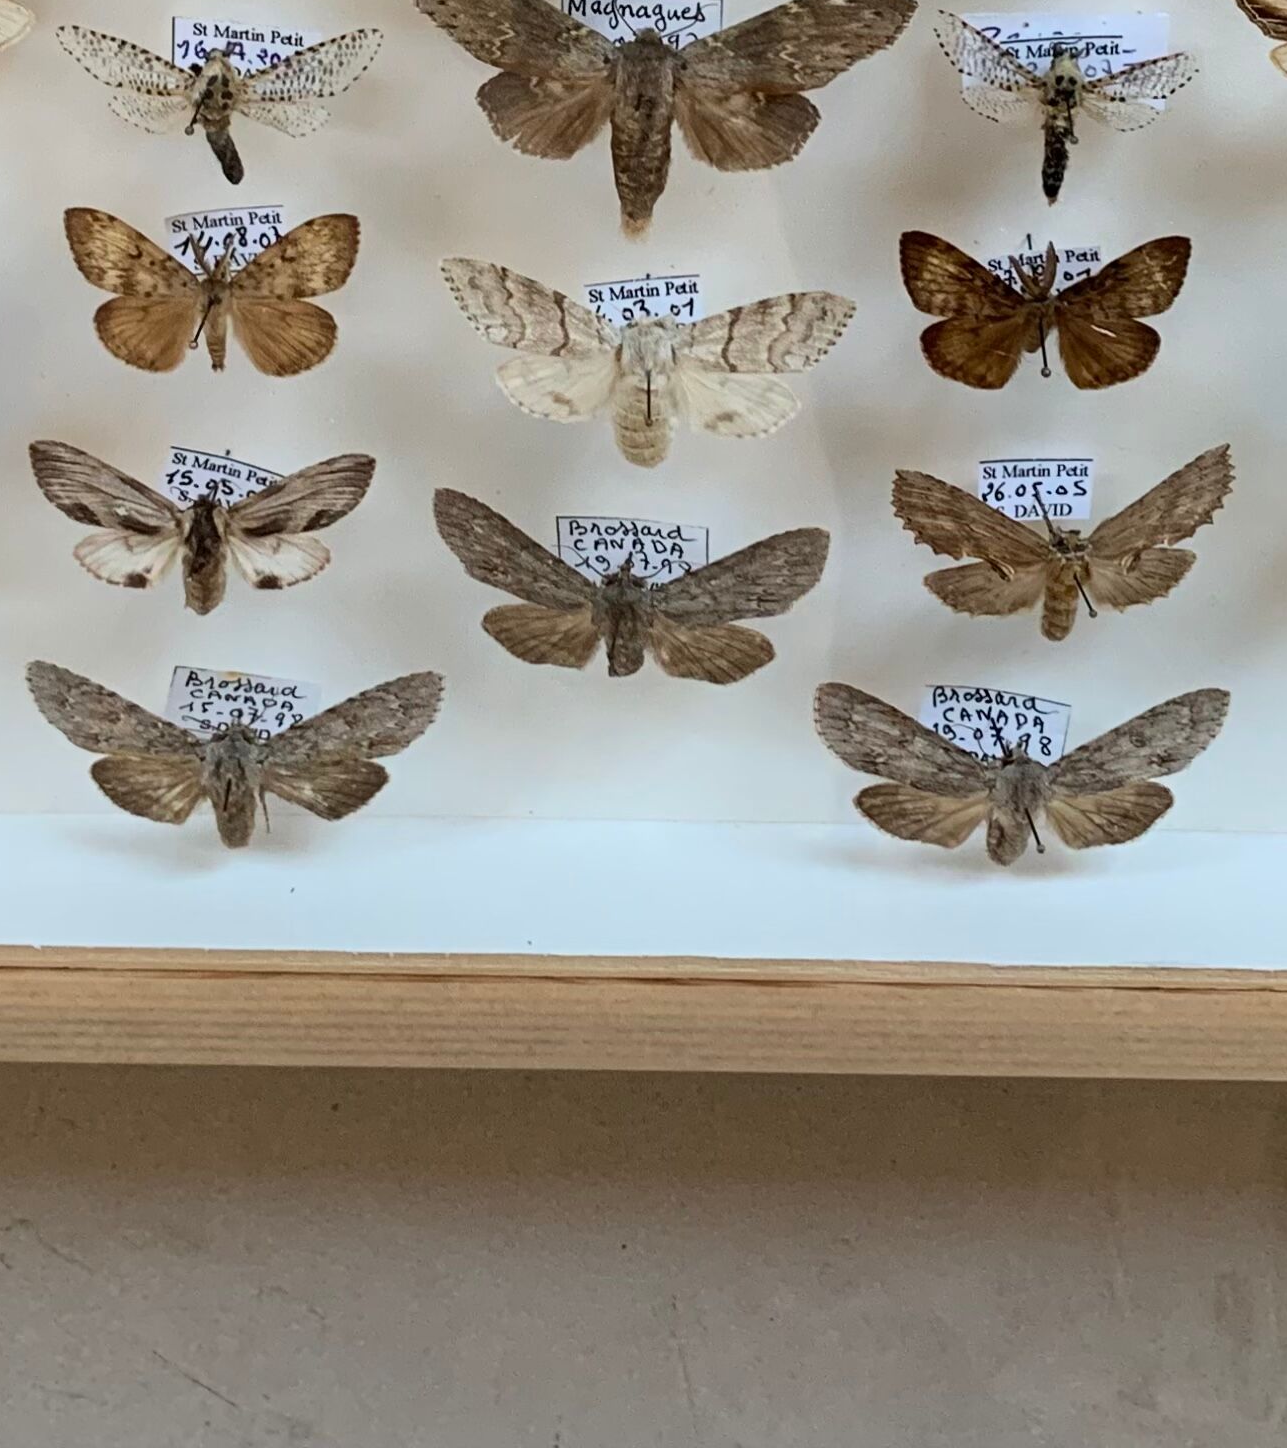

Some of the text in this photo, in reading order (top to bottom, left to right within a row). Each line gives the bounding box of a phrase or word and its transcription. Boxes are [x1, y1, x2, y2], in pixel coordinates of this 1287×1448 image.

[193, 23, 304, 48] St Martin Petit
[1025, 42, 1079, 60] Man
[1082, 40, 1120, 57] Petit
[171, 210, 282, 233] St Martin Petit
[987, 259, 1003, 272] St
[1064, 249, 1101, 263] Petit
[588, 279, 699, 303] St Martin Petit
[172, 453, 187, 466] St
[192, 456, 242, 479] Martin
[982, 463, 1089, 480] St Martin Petit
[1014, 503, 1072, 519] DAVID
[574, 537, 684, 559] CANADA
[190, 689, 294, 712] CANADA
[943, 707, 1044, 734] CANADA
